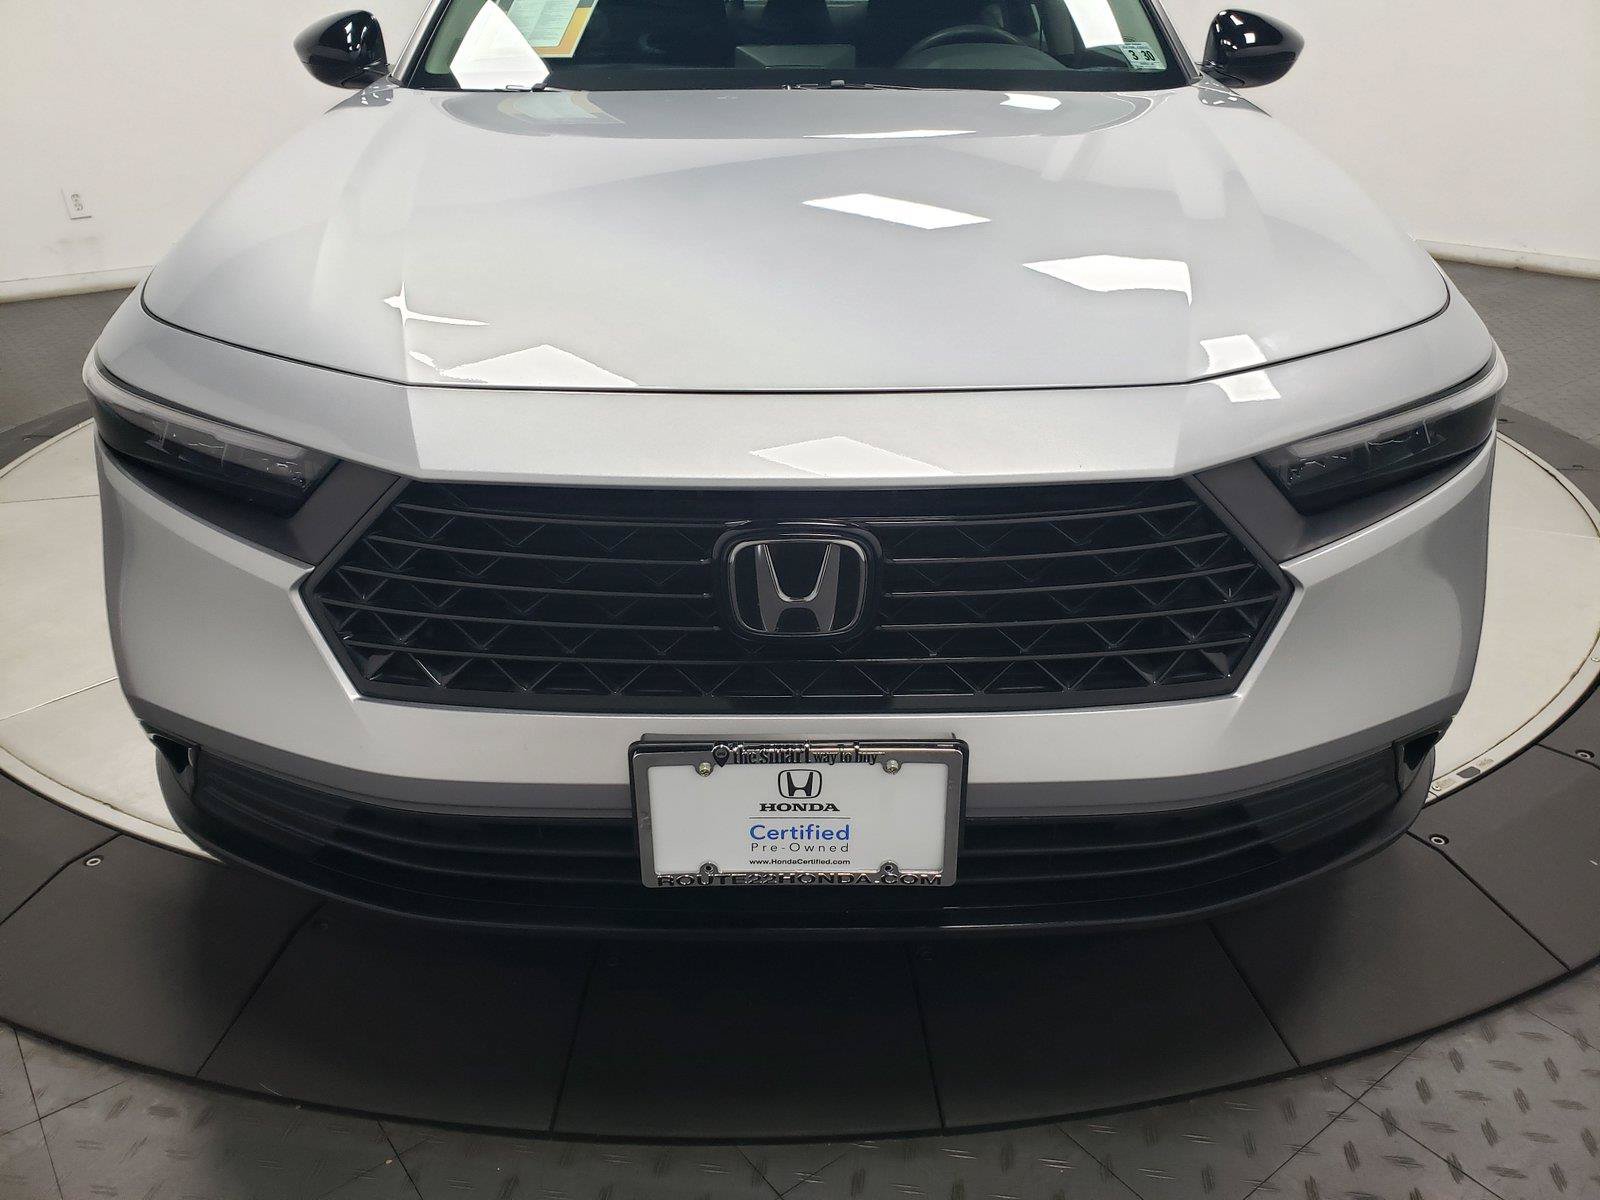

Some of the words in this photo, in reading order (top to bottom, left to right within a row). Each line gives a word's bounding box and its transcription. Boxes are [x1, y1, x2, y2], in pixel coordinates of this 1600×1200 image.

[1129, 50, 1139, 60] 3
[1141, 50, 1155, 61] 30
[733, 745, 758, 764] the
[812, 751, 837, 766] way
[839, 747, 852, 764] to
[854, 746, 878, 766] buy
[759, 803, 840, 812] HONDA
[749, 823, 851, 842] Certified
[751, 842, 850, 853] Pre-Owned
[748, 858, 852, 866] www.HondaCertified.com
[657, 872, 942, 886] ROUTE22HONDA.COM
